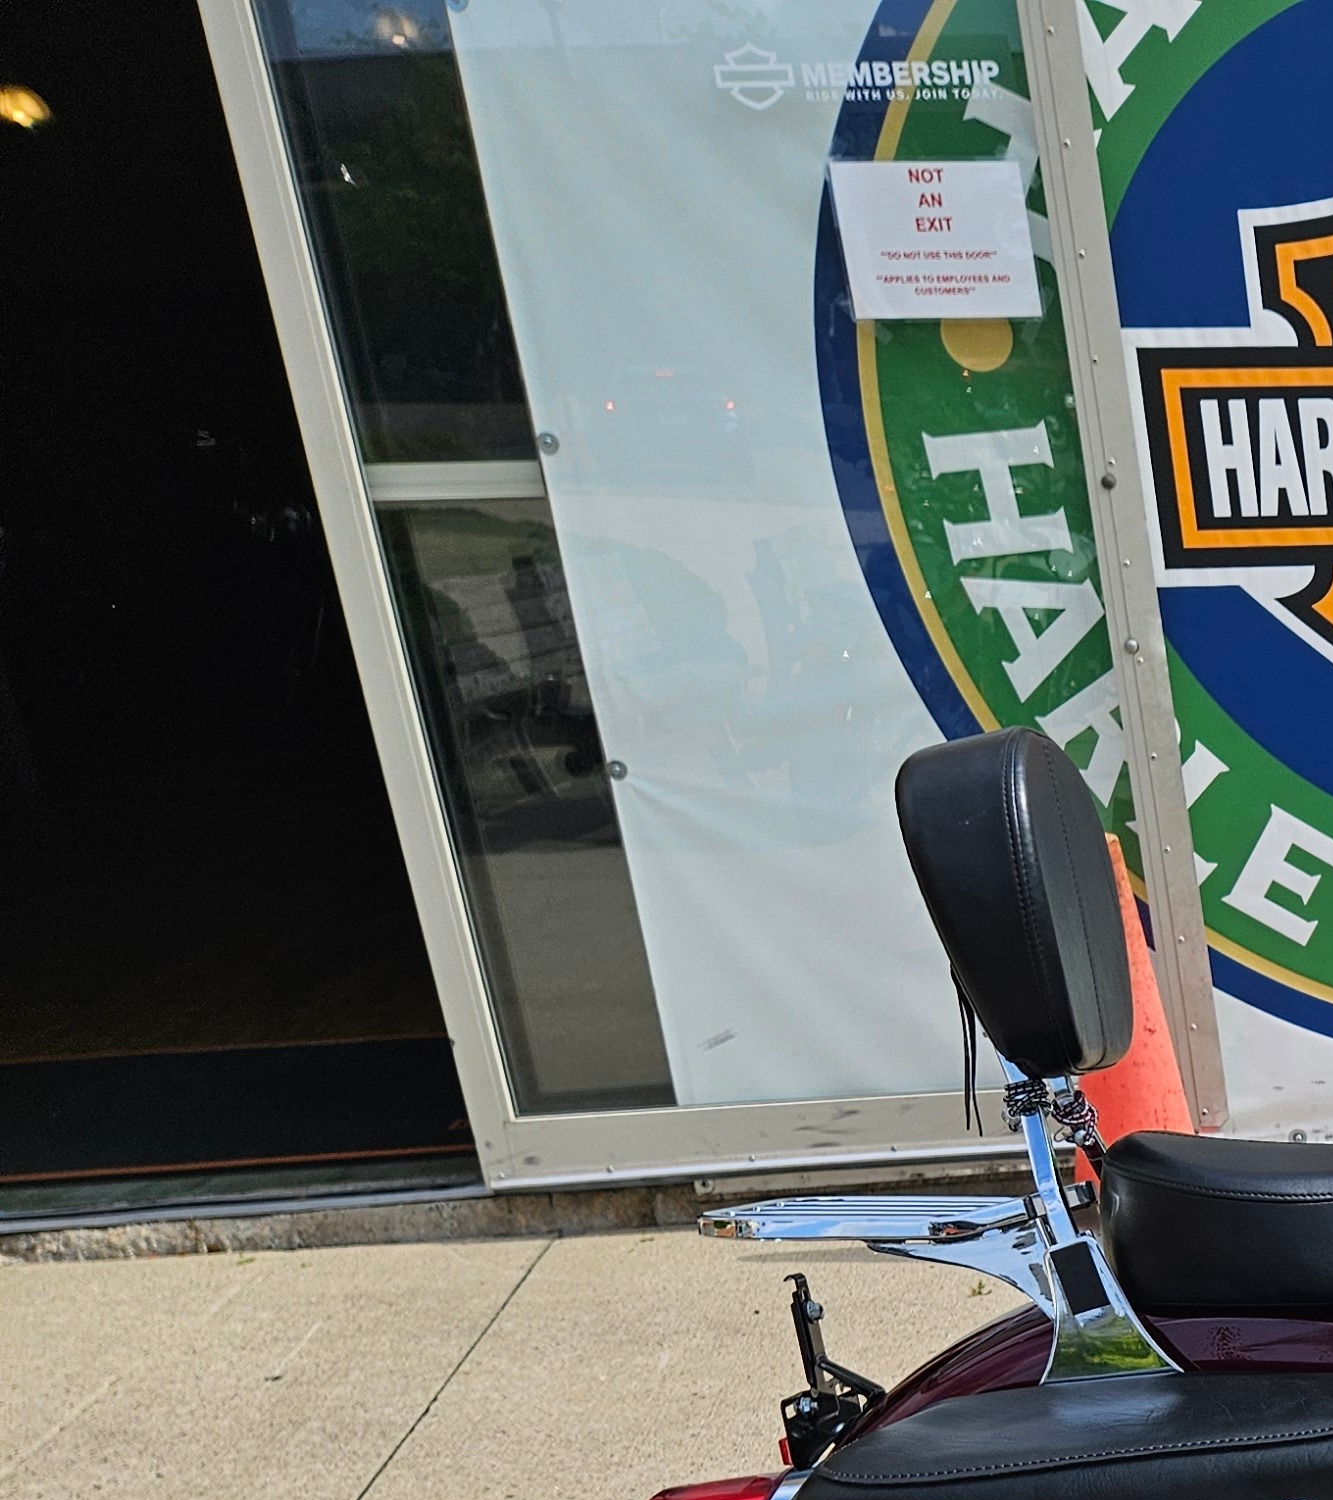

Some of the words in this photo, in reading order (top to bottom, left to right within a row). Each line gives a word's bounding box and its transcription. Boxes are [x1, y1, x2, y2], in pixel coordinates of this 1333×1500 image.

[801, 60, 1000, 88] MEMBERSHIP
[845, 91, 882, 102] WITH
[915, 89, 948, 100] JOIN
[908, 168, 943, 184] NOT
[919, 193, 943, 208] AN
[915, 217, 953, 232] EXIT
[903, 250, 921, 260] NOT
[924, 250, 942, 260] USE
[944, 250, 964, 260] THIS
[922, 275, 935, 284] TO
[936, 274, 990, 284] EMPLOYEES
[991, 274, 1011, 283] AND
